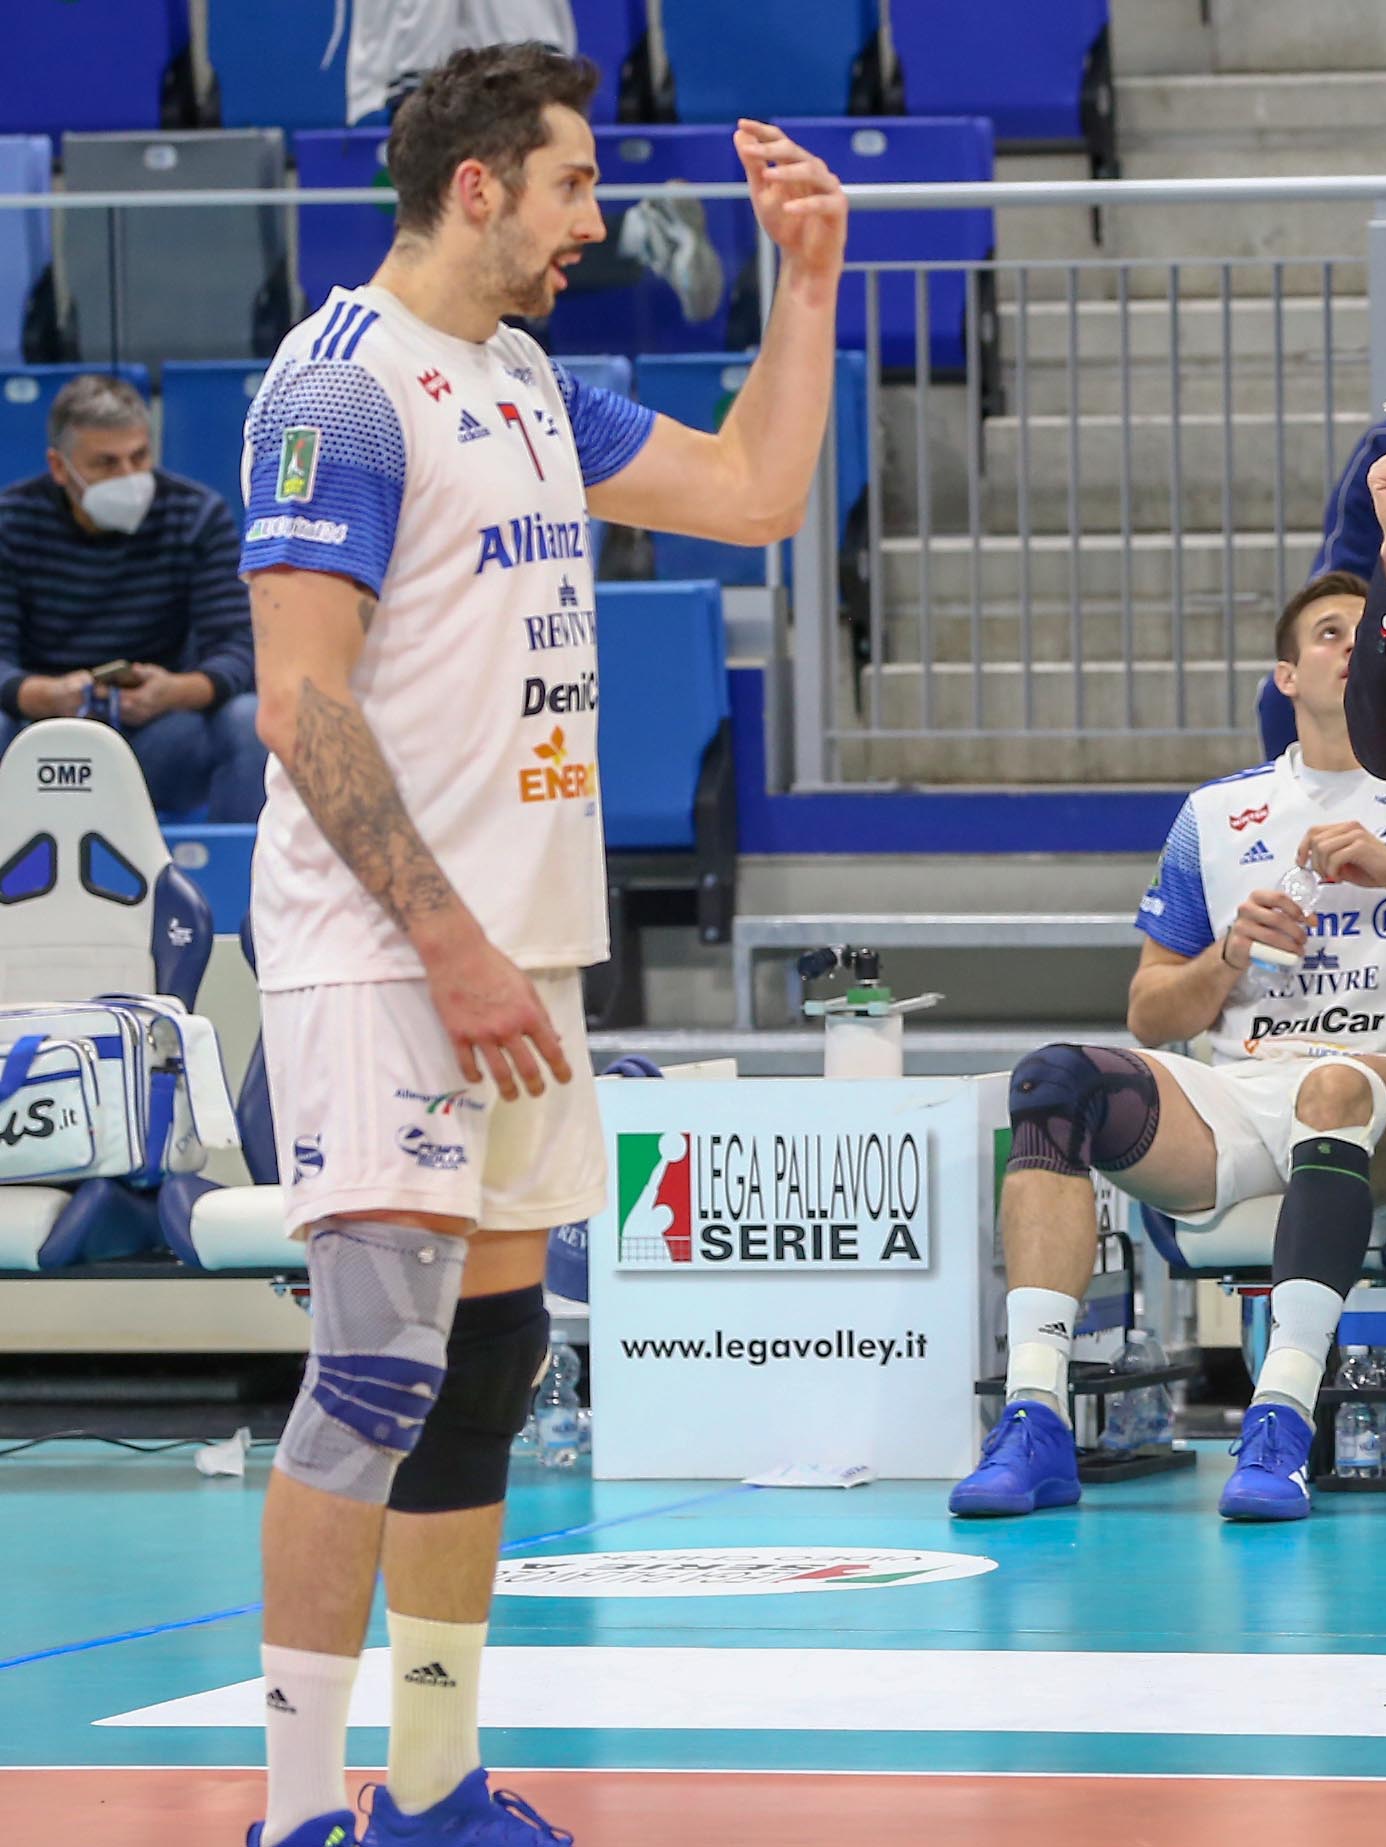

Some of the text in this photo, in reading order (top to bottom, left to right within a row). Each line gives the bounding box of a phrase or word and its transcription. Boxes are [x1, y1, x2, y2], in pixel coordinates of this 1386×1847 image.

[496, 402, 545, 481] 7
[38, 765, 92, 785] OMP
[1251, 1007, 1385, 1040] DeniCar
[697, 1133, 920, 1220] LEGA PALLAVOLO
[700, 1224, 921, 1262] SERIE A
[620, 1329, 927, 1365] www.legavolley.it
